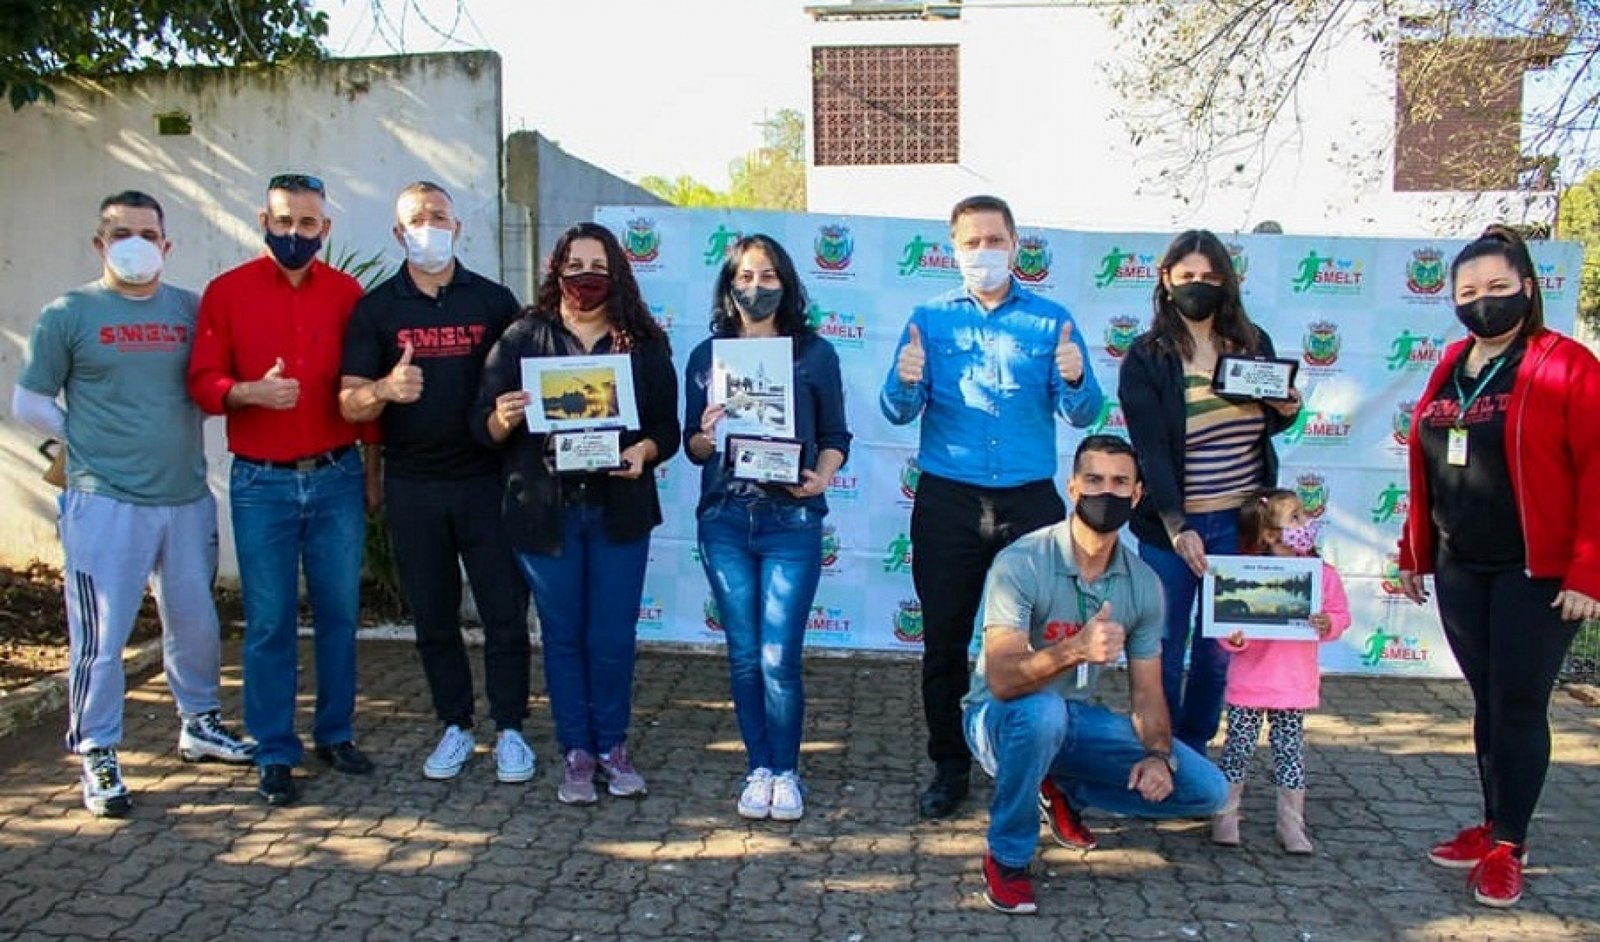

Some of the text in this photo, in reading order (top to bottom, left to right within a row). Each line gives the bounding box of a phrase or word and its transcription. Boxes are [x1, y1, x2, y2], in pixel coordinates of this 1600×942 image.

[918, 255, 959, 269] SMEL
[1313, 271, 1363, 284] SMELT
[1538, 277, 1566, 289] ELT
[100, 325, 188, 344] SMELT
[397, 325, 486, 347] SMELT
[1304, 424, 1351, 436] SMELT
[829, 477, 857, 489] ELT
[639, 608, 663, 619] ELT
[1380, 648, 1428, 661] SMELT
